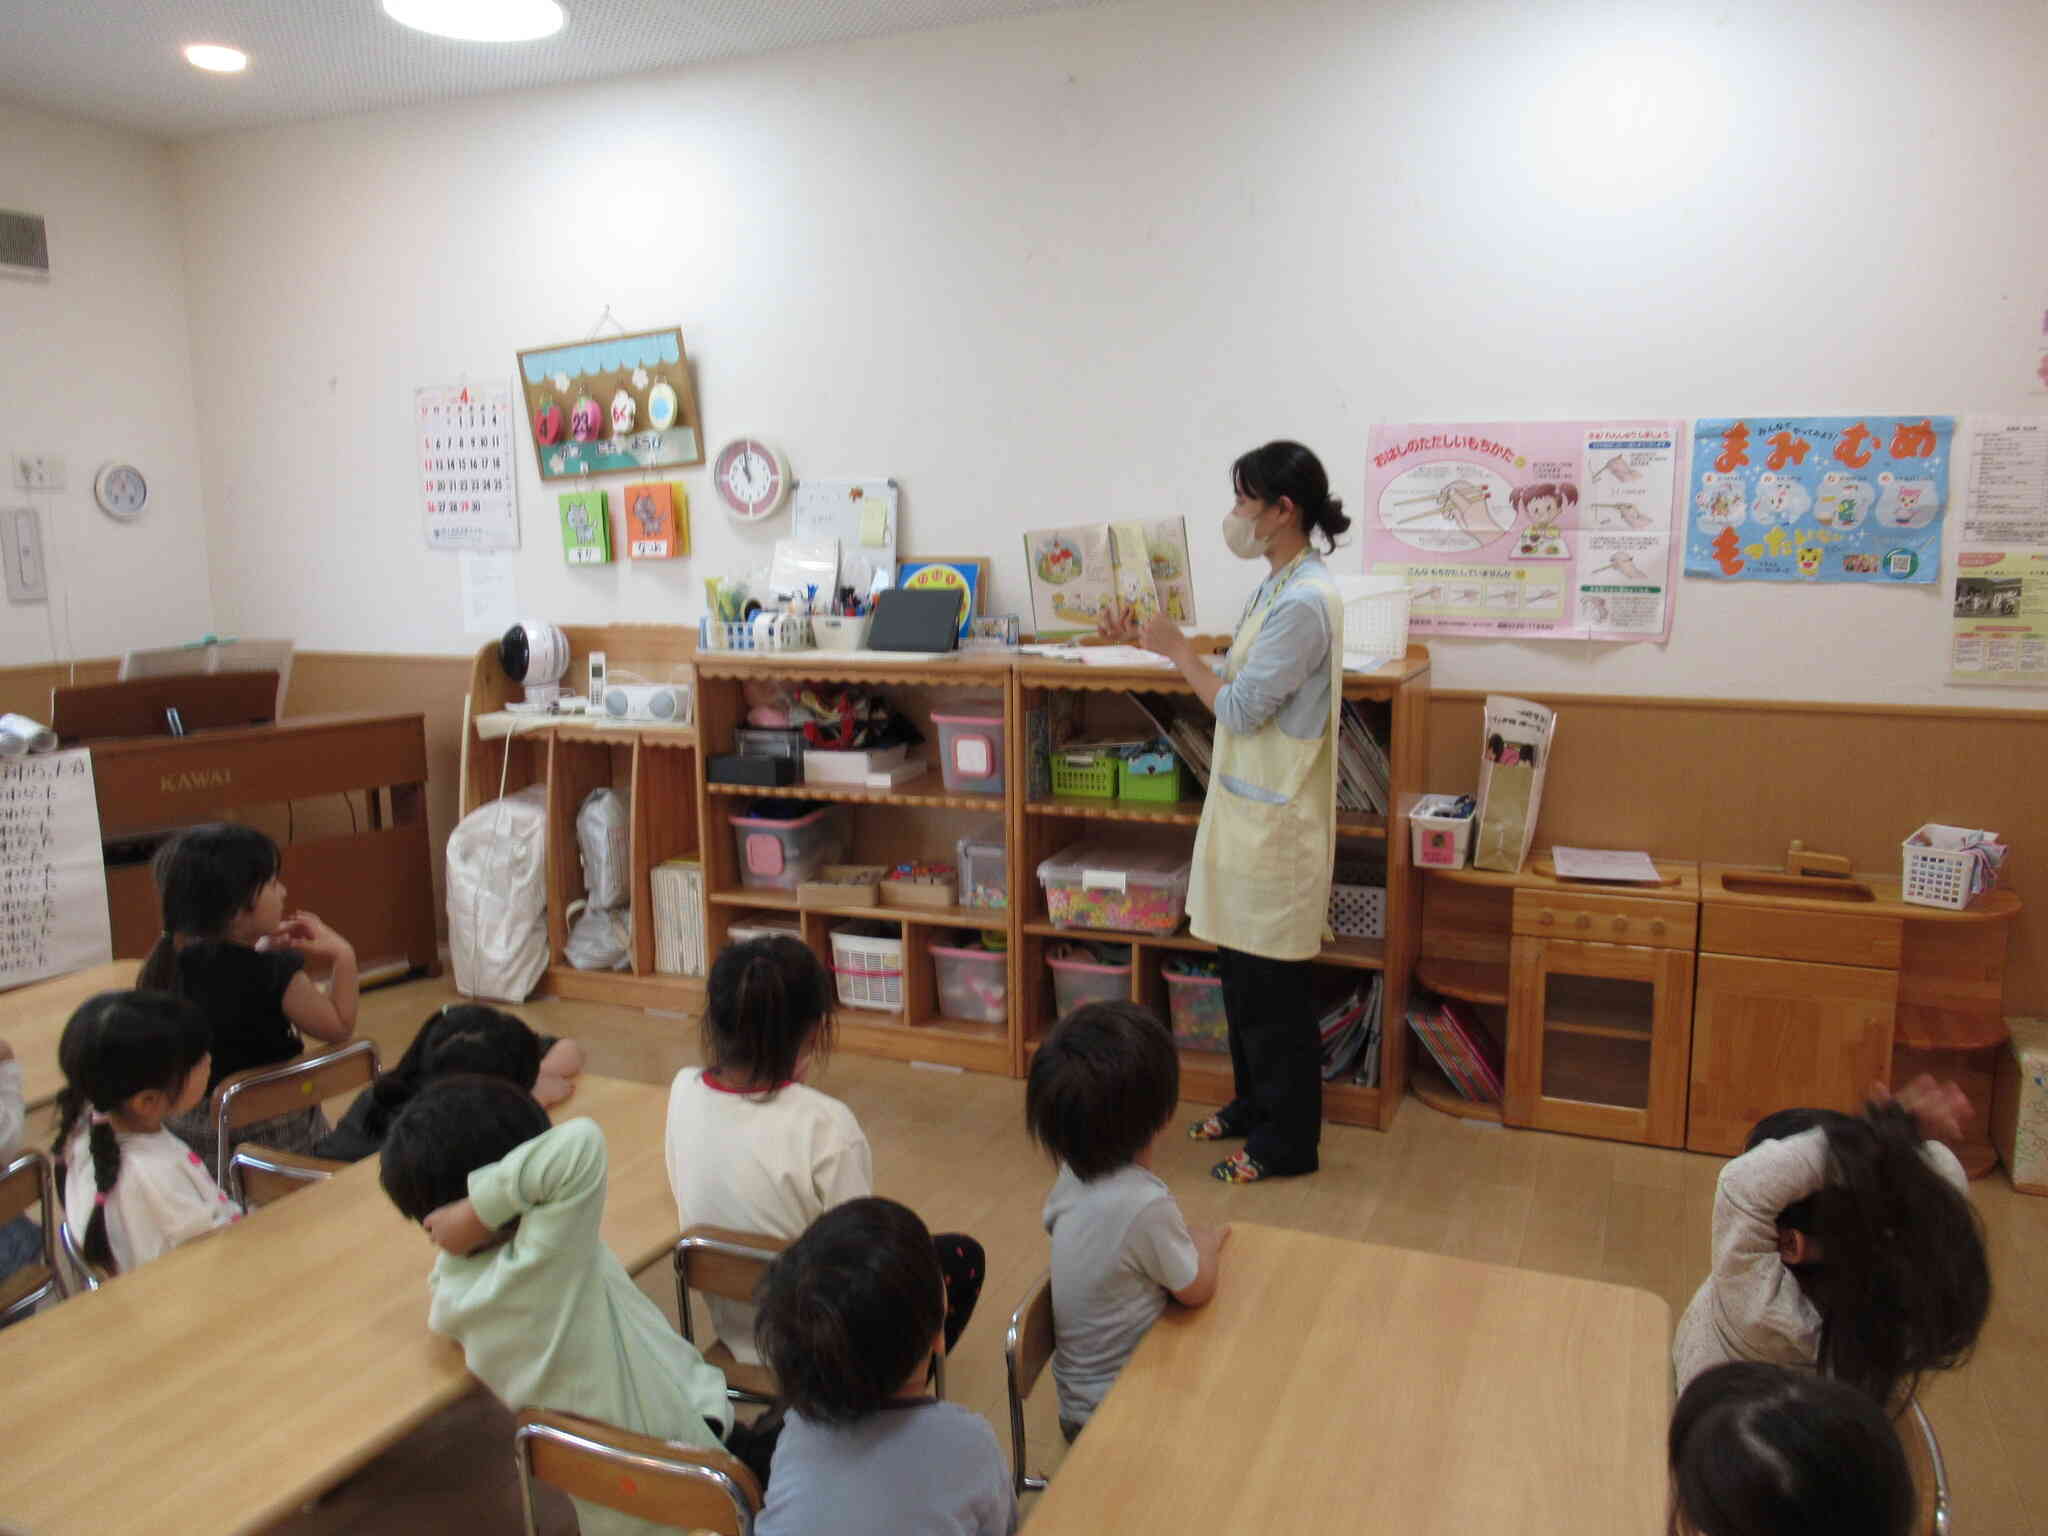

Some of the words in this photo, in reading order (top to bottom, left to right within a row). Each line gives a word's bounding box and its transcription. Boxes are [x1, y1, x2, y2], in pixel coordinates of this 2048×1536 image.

[1374, 433, 1516, 469] おはしのただしいもちかた
[160, 767, 232, 792] KAWAI
